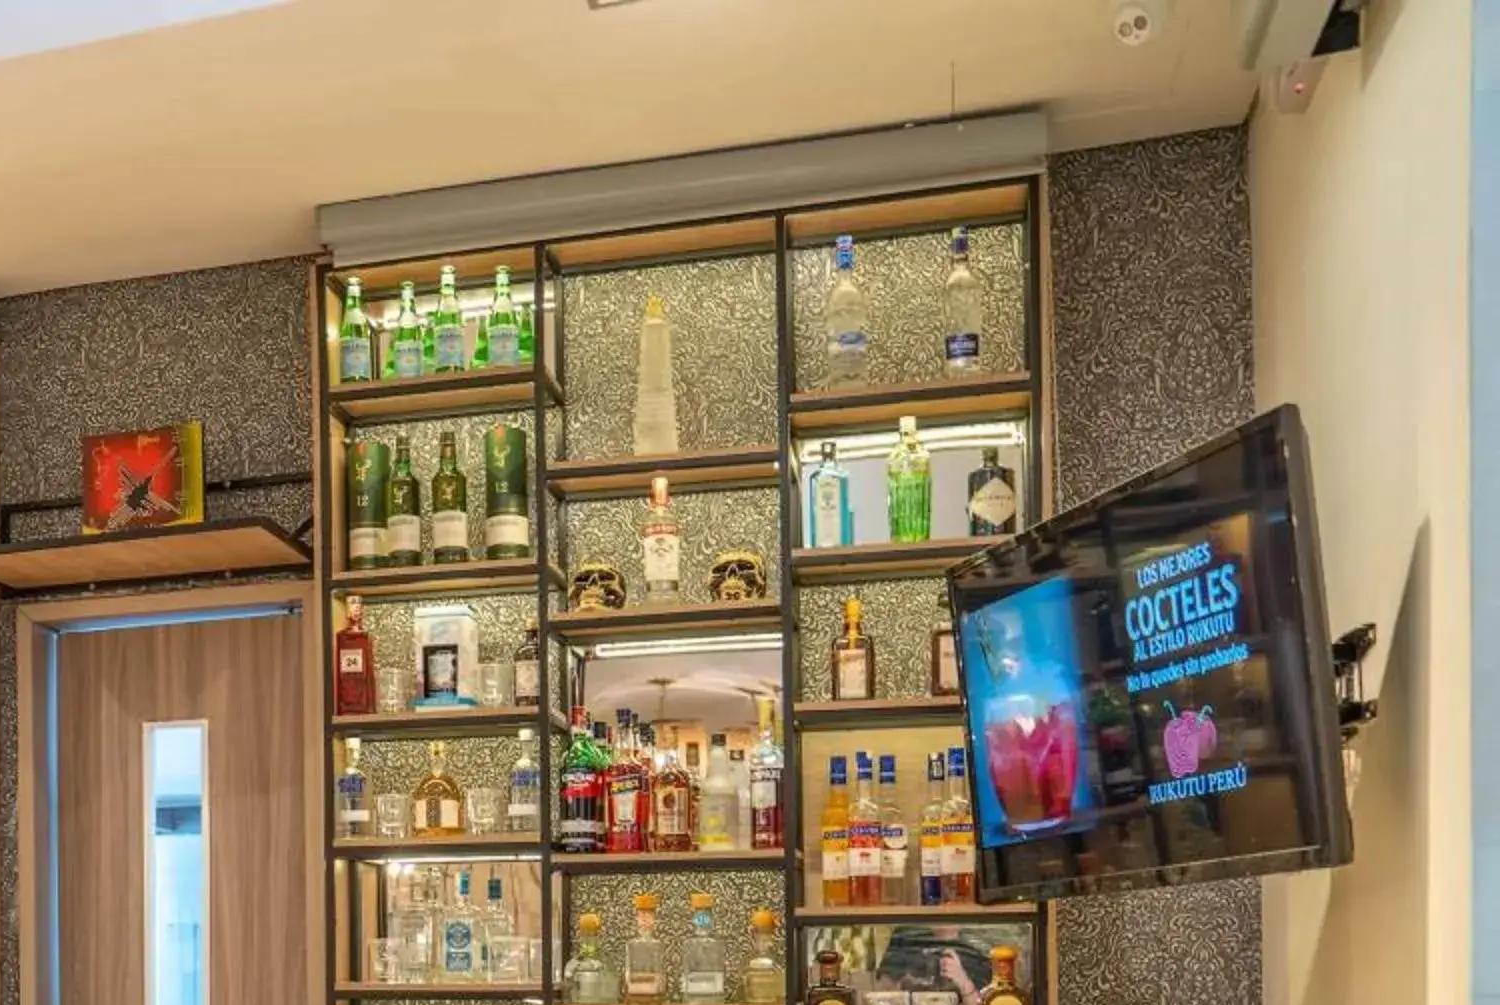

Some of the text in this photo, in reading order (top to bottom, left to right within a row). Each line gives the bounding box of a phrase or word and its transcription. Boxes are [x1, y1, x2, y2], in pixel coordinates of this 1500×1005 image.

[1136, 541, 1212, 589] LOS MEJORES
[1125, 563, 1239, 641] COCTELES
[1133, 610, 1235, 663] AL ESTILO RUKUTU
[1147, 760, 1248, 805] RUKUTU PERÚ
